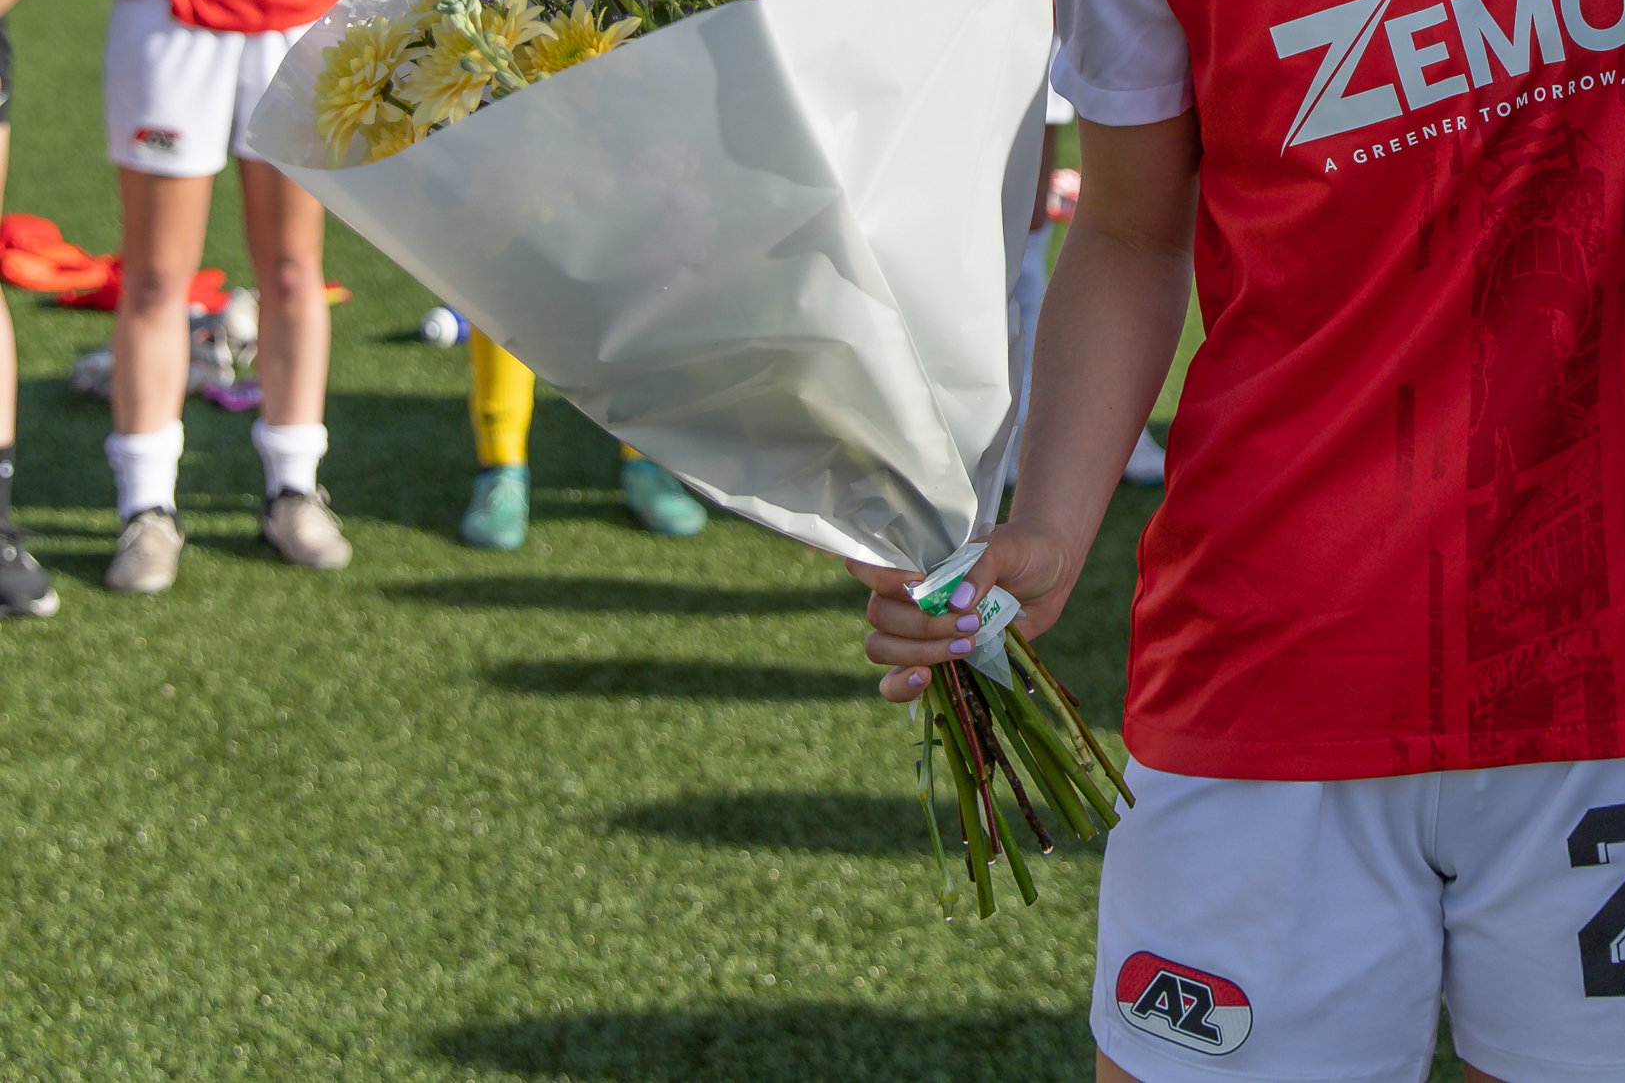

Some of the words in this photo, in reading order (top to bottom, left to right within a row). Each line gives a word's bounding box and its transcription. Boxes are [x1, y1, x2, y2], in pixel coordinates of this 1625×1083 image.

[1324, 156, 1338, 173] A
[1353, 115, 1468, 165] GREENER
[1131, 970, 1222, 1047] AZ
